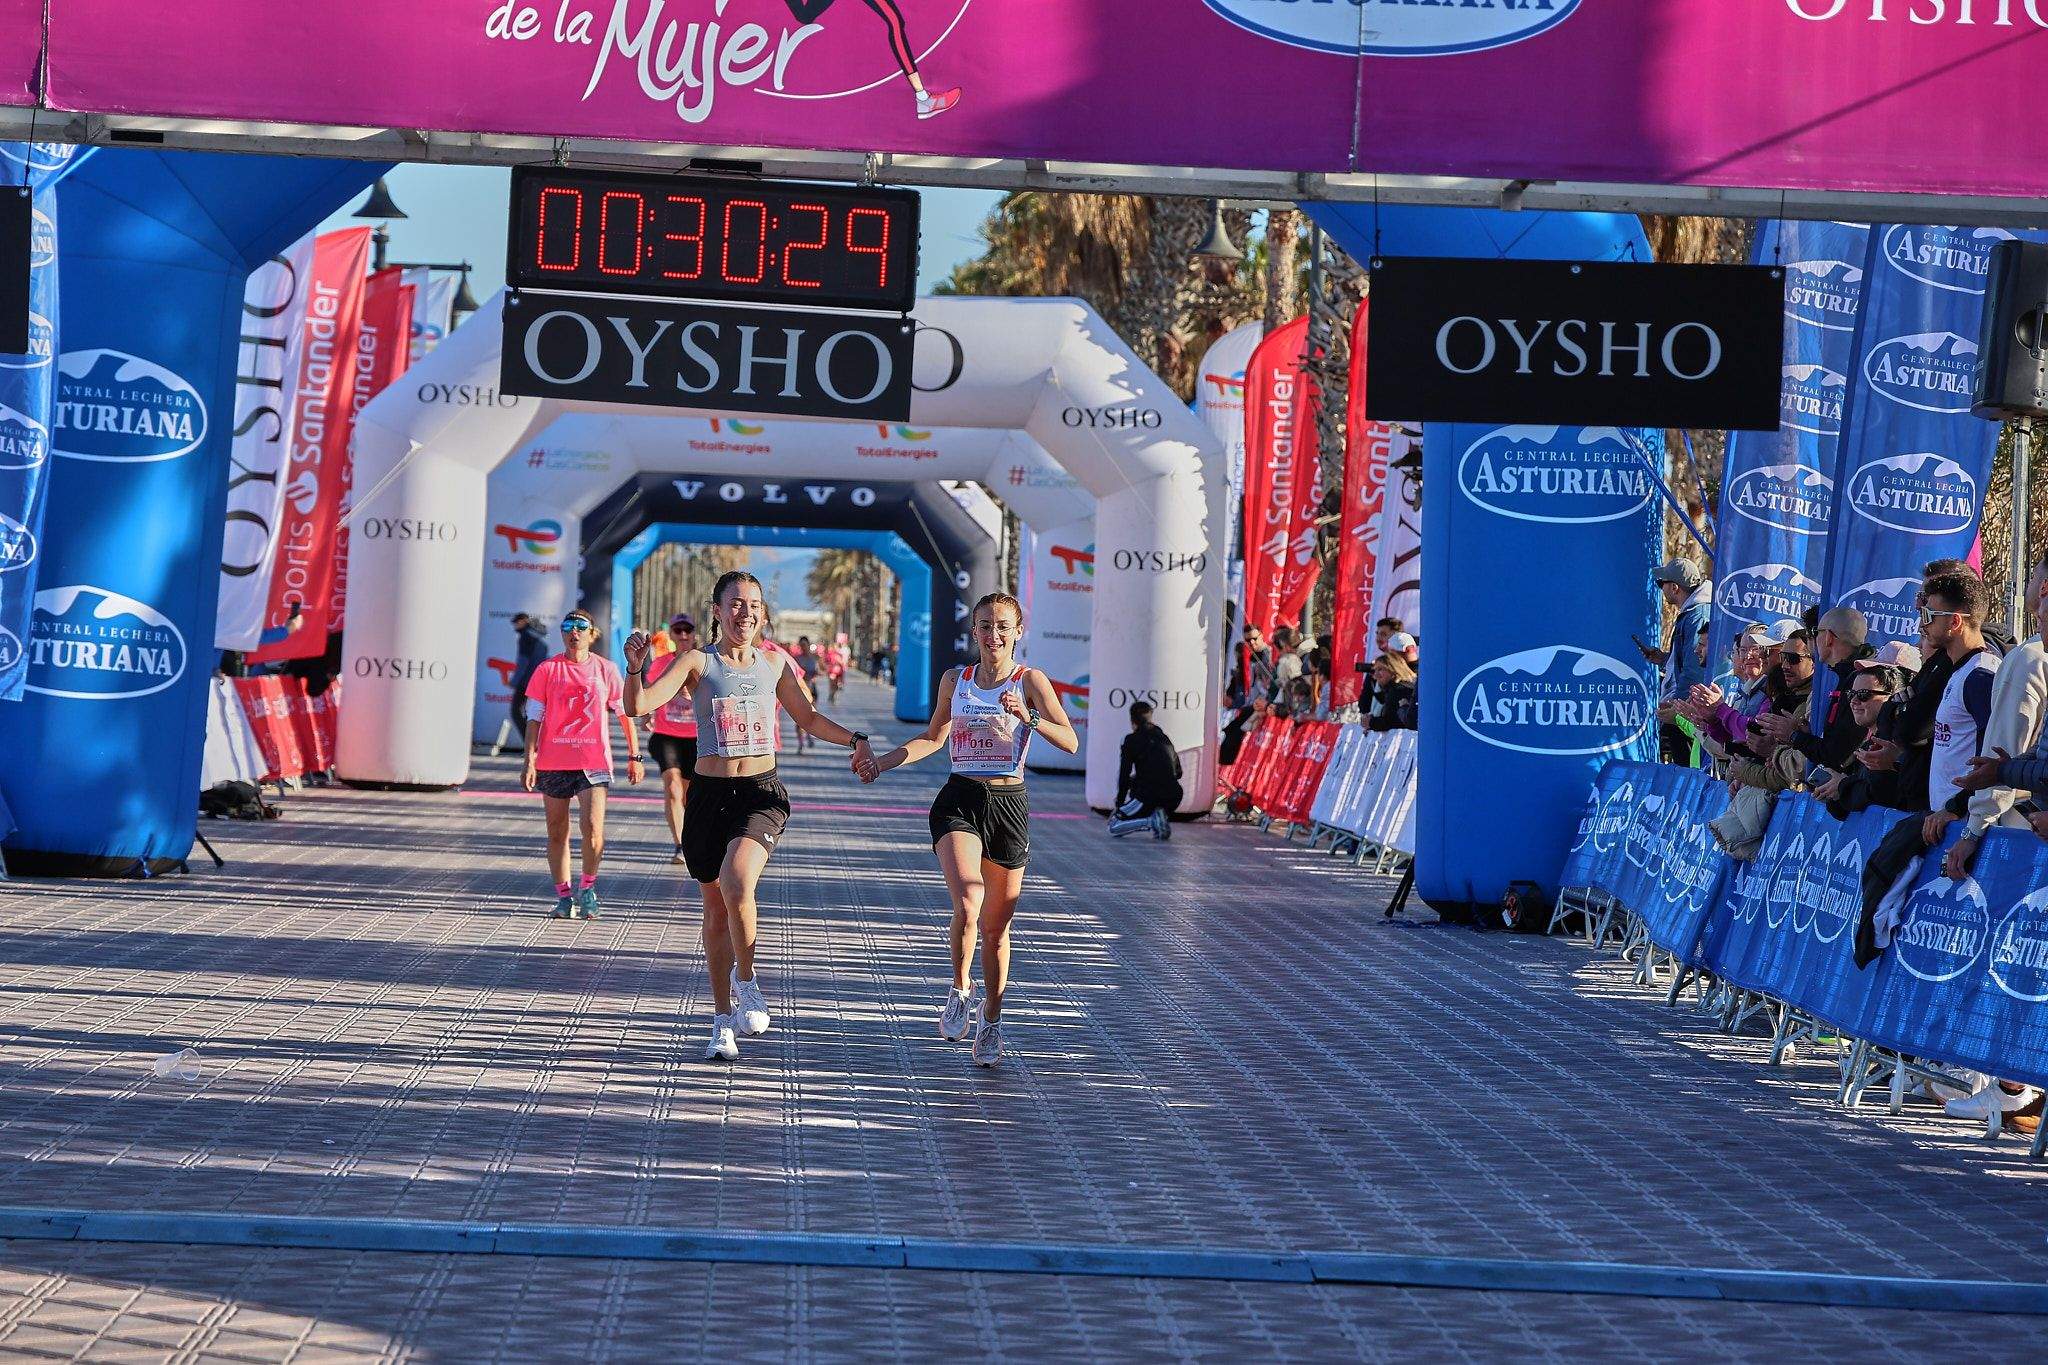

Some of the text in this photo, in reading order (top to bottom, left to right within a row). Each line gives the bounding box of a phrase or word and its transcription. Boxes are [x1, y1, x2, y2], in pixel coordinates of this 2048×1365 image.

[485, 0, 594, 44] de la
[581, 0, 825, 123] Mujer
[536, 187, 890, 289] 00:30:29
[523, 309, 894, 405] OYSHO
[1435, 315, 1723, 381] OYSHO
[291, 280, 339, 465] Santander
[62, 384, 191, 408] NTRAL LECHERA
[417, 382, 519, 408] OYSHO
[1783, 383, 1820, 397] ENTRAL
[54, 400, 195, 442] TURIANA
[1062, 405, 1162, 431] OYSHO
[688, 439, 771, 455] TotalEnergies
[856, 446, 939, 461] TotalEnergies
[1265, 367, 1294, 525] Santander
[1504, 450, 1640, 465] CENTRAL LECHER
[1471, 452, 1647, 497] ASTURIANA
[1882, 475, 1933, 489] CENTRAL
[672, 480, 876, 508] VOLVO
[363, 517, 458, 543] OYSHO
[1114, 549, 1207, 573] OYSHO
[31, 621, 170, 643] ENTRAL LECHERA
[31, 637, 173, 676] TURIANA
[353, 655, 448, 682] OYSHO
[1109, 687, 1201, 710] OYSHO
[1499, 682, 1638, 695] CENTRAL LECHERA
[1466, 683, 1641, 727] ASTURIANA
[738, 722, 761, 733] 06
[970, 738, 994, 749] 016
[1897, 903, 1979, 958] ASTURIANA
